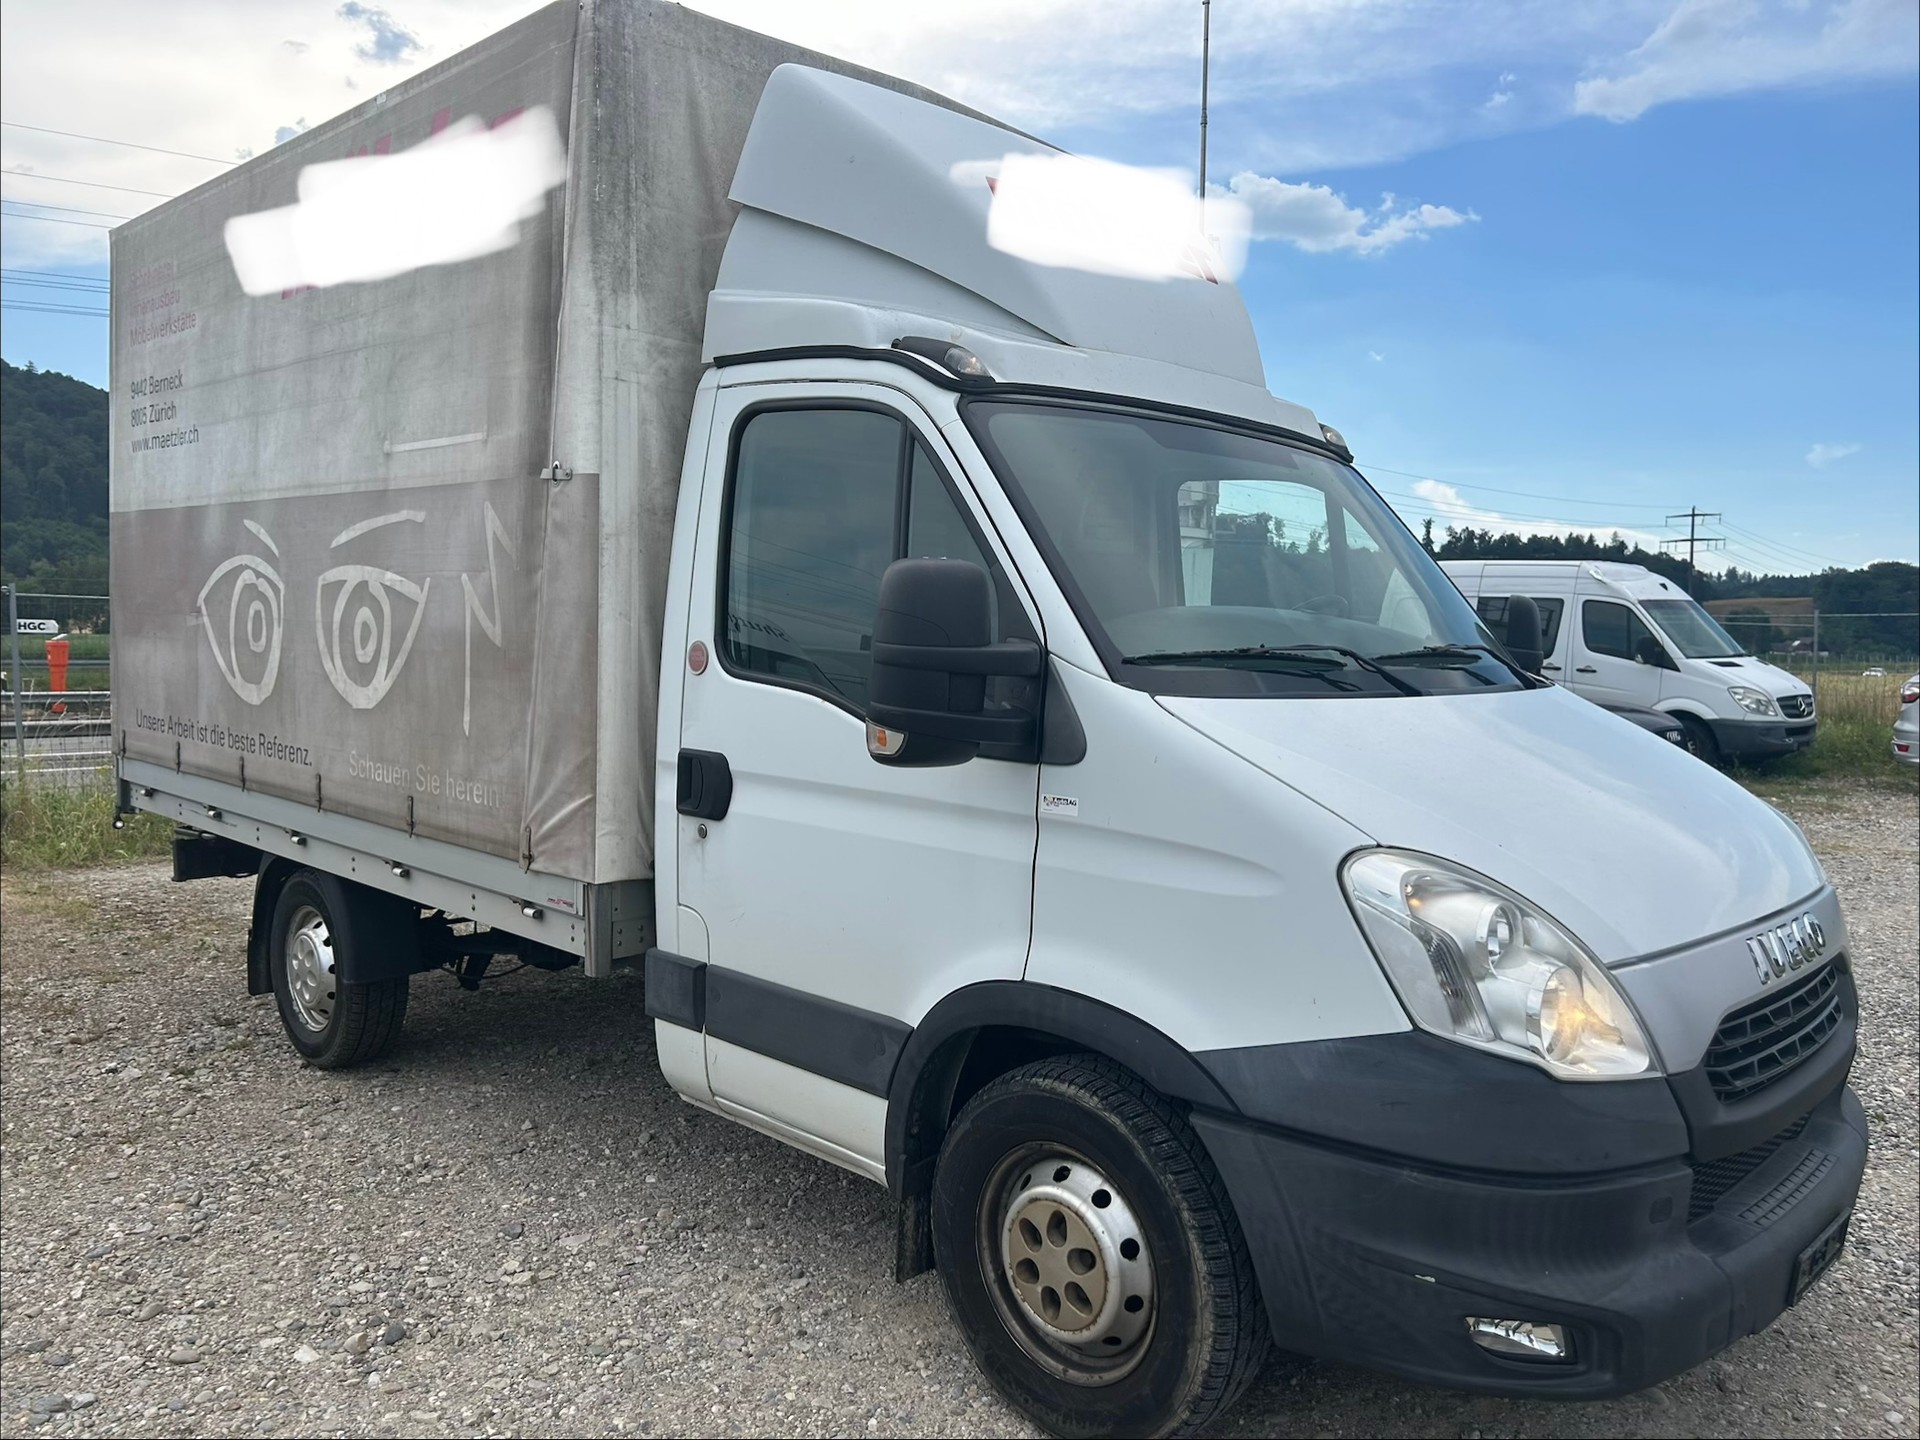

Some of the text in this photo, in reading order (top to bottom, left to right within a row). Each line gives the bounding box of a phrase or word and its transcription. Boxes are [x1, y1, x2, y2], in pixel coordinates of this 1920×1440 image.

[130, 312, 197, 347] Möbelwerkstätte
[131, 369, 183, 399] 9442 Berneck
[149, 401, 177, 422] Zürich
[131, 424, 199, 453] www.maetzler.ch
[18, 622, 46, 631] HGC
[136, 708, 312, 766] Unsere Arbeit ist die beste Referenz.
[349, 751, 410, 787] Schauen
[416, 764, 440, 795] Sie
[1745, 911, 1826, 985] IVECO
